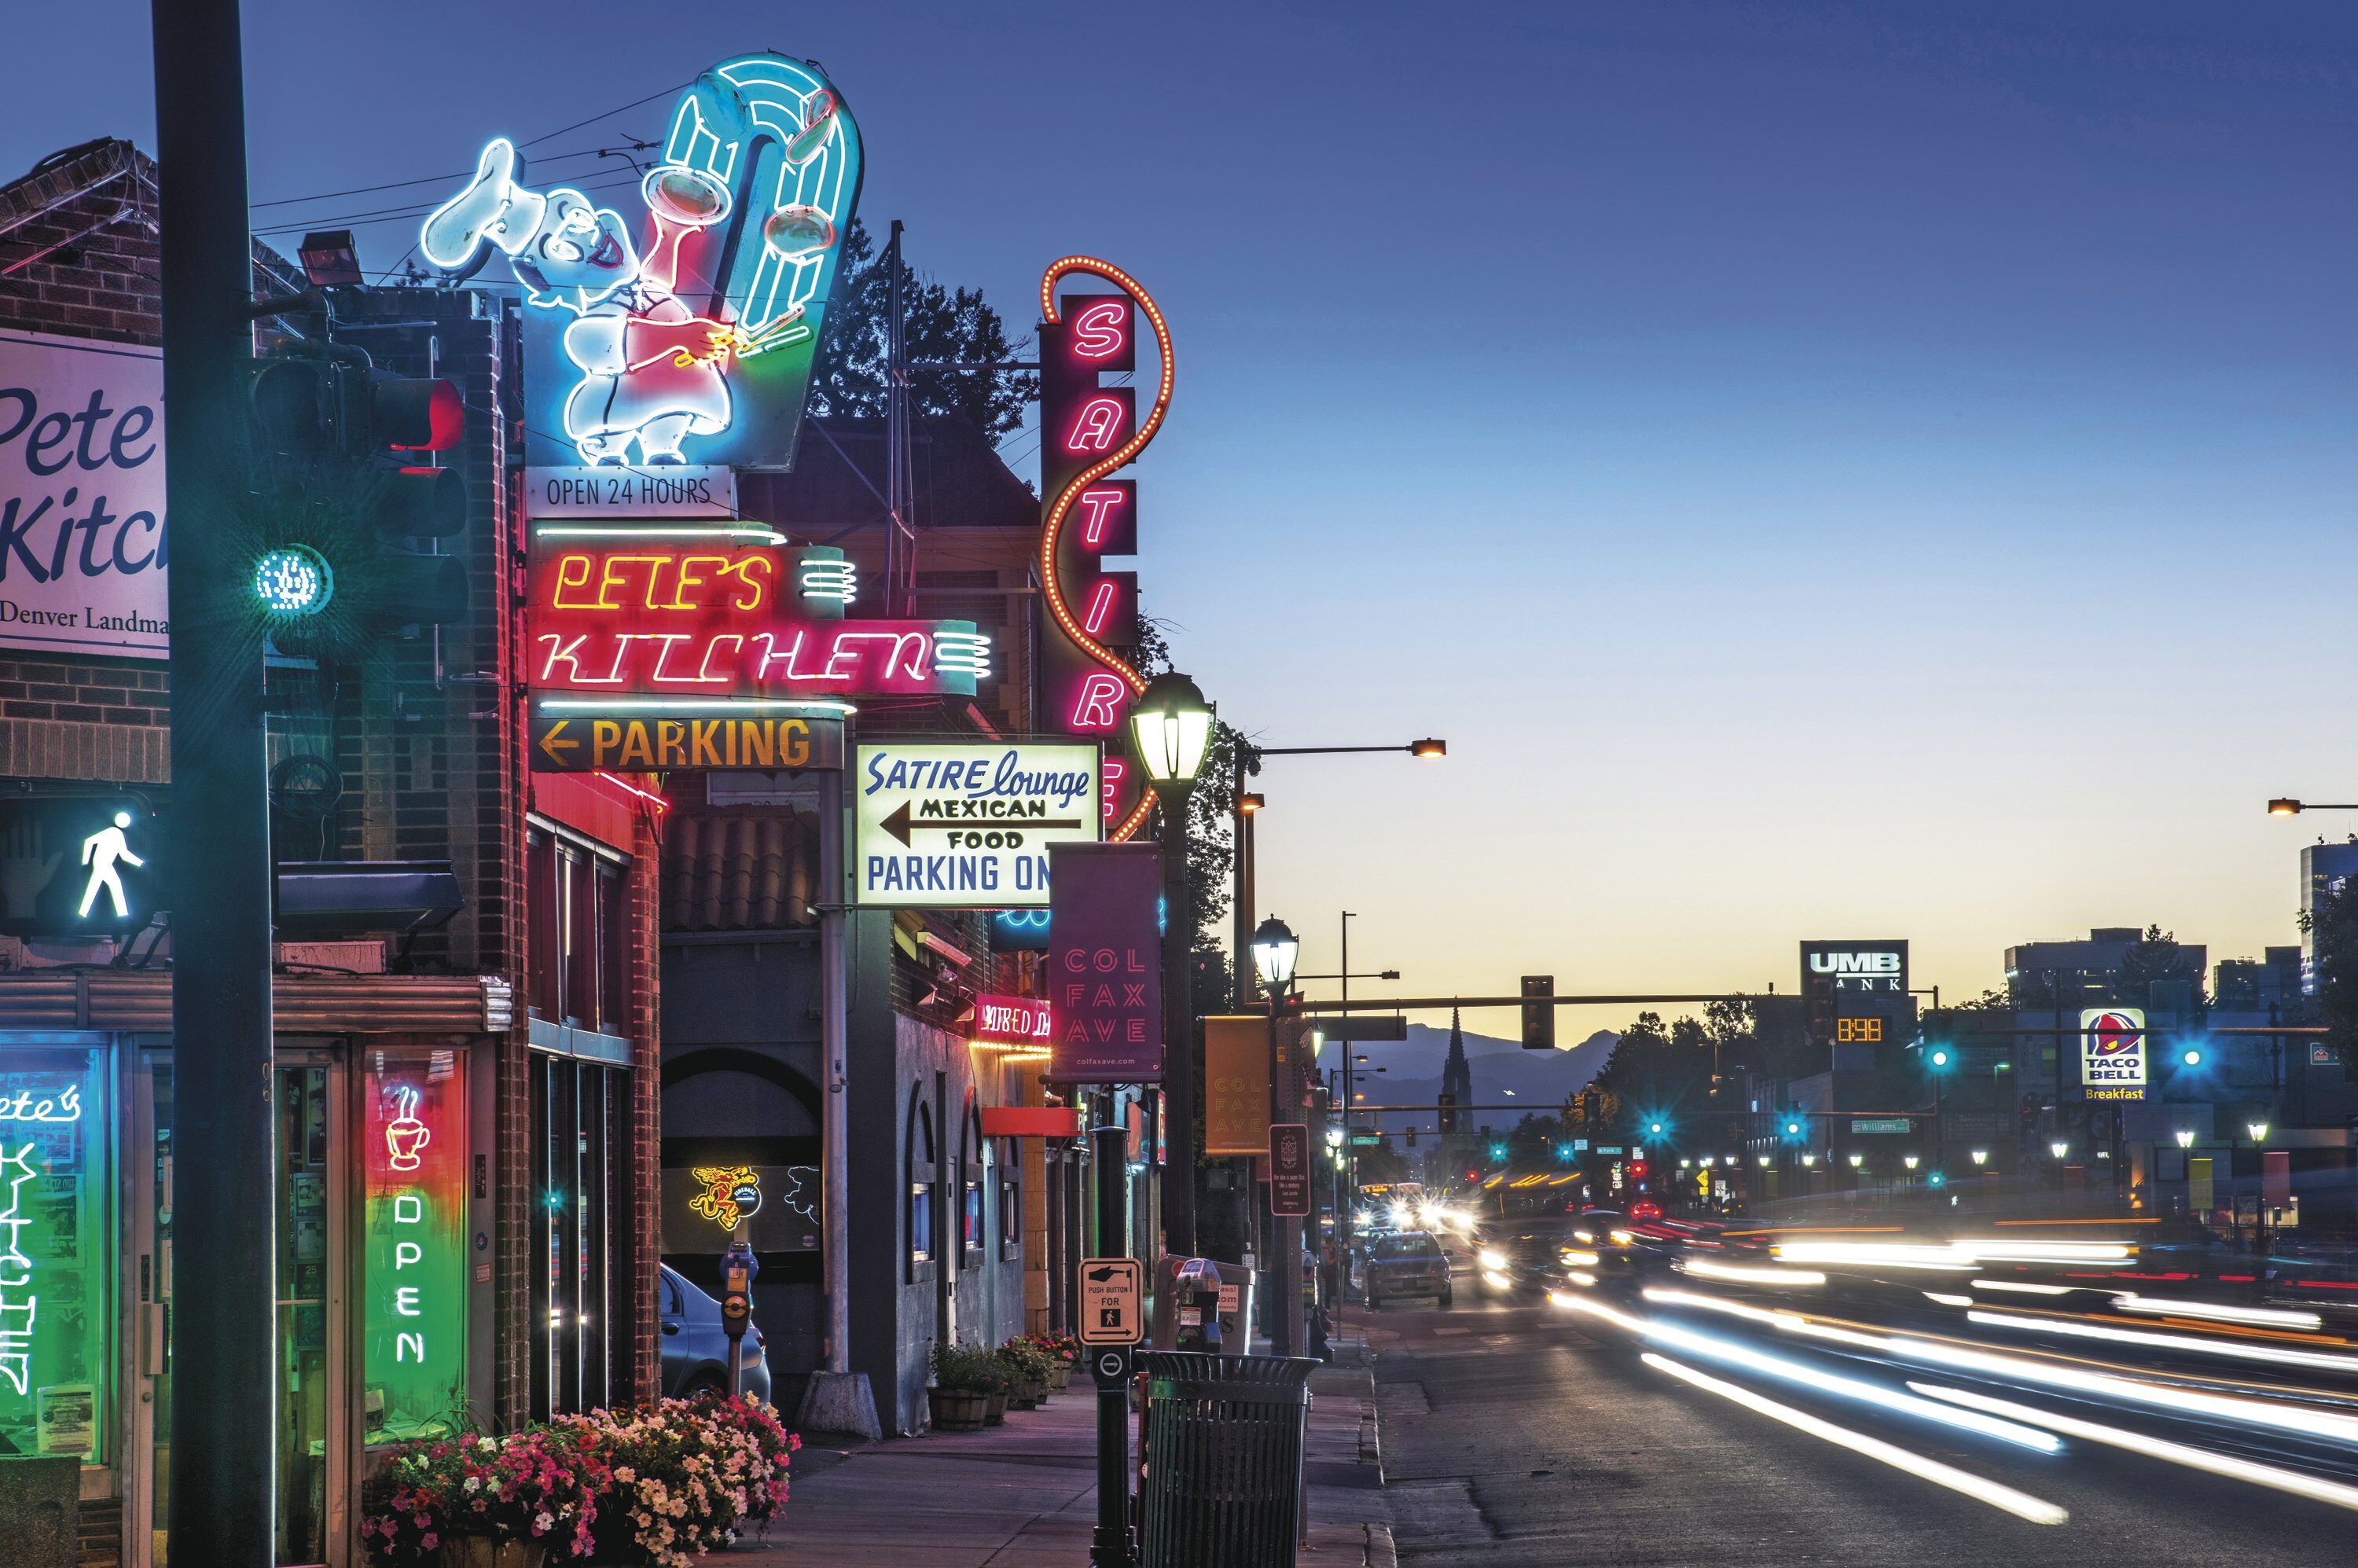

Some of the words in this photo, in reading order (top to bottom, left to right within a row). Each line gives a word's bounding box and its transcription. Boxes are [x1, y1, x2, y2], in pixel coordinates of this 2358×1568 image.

[0, 387, 164, 476] Pete
[547, 479, 599, 505] OPEN
[608, 479, 633, 505] 24
[642, 478, 711, 504] HOURS
[554, 556, 773, 610] PETE'S
[0, 600, 77, 627] Denver
[538, 630, 932, 683] KITCHEN
[593, 720, 810, 766] PARKING
[865, 751, 990, 796] SATIRE
[967, 750, 1089, 809] lounge
[919, 799, 1046, 818] MEXICAN
[947, 831, 1024, 850] FOOD
[868, 855, 998, 890] PARKING
[1065, 948, 1145, 972] COL
[1810, 953, 1901, 973] UMB
[1067, 983, 1145, 1007] FAX
[1836, 979, 1901, 990] ANK
[1065, 1019, 1145, 1042] AVE
[2085, 1059, 2139, 1068] TACO
[1214, 1078, 1261, 1092] COL
[2089, 1070, 2141, 1080] BELL
[2086, 1088, 2143, 1100] Breakfast
[1215, 1098, 1262, 1113] FAX
[1214, 1118, 1262, 1133] AVE
[1861, 1122, 1896, 1131] Williams
[734, 1187, 756, 1197] FIREBALL
[395, 1195, 423, 1363] OPEN
